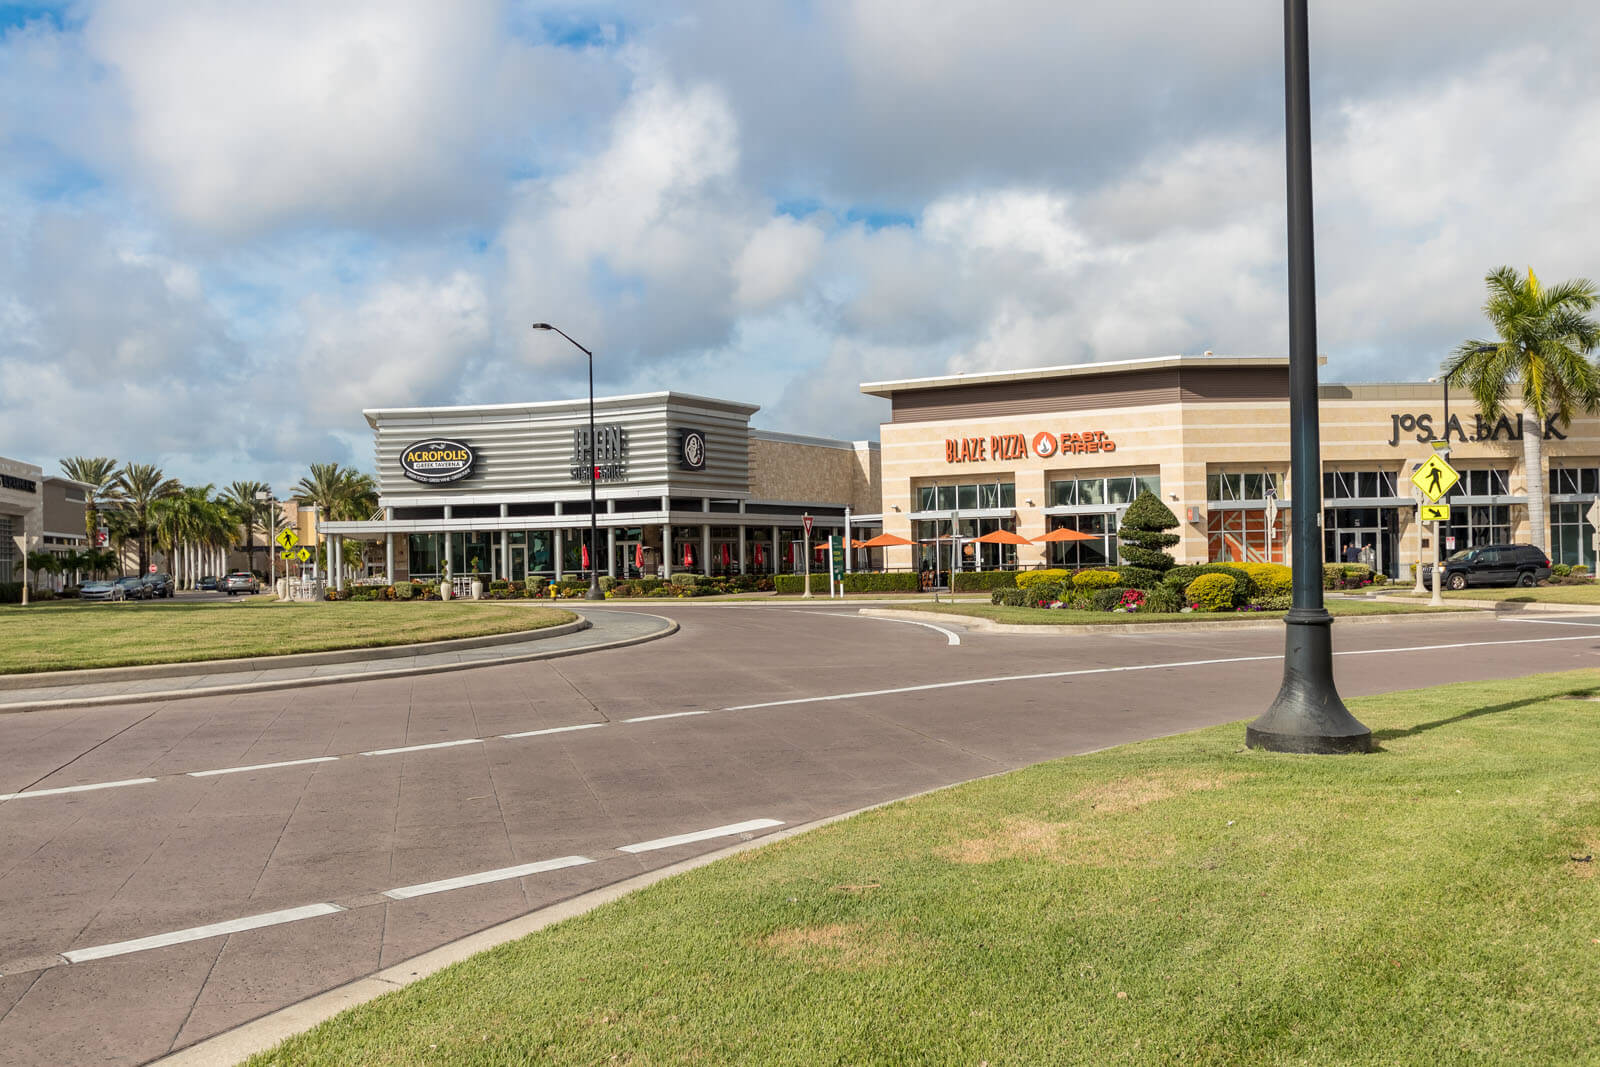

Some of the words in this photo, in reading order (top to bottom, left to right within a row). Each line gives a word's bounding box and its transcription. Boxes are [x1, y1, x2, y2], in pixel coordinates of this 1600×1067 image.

[945, 437, 986, 463] BLAZE
[990, 434, 1028, 460] PIZZA
[1061, 441, 1116, 454] FIRE'D
[407, 450, 467, 462] ACROPOLIS
